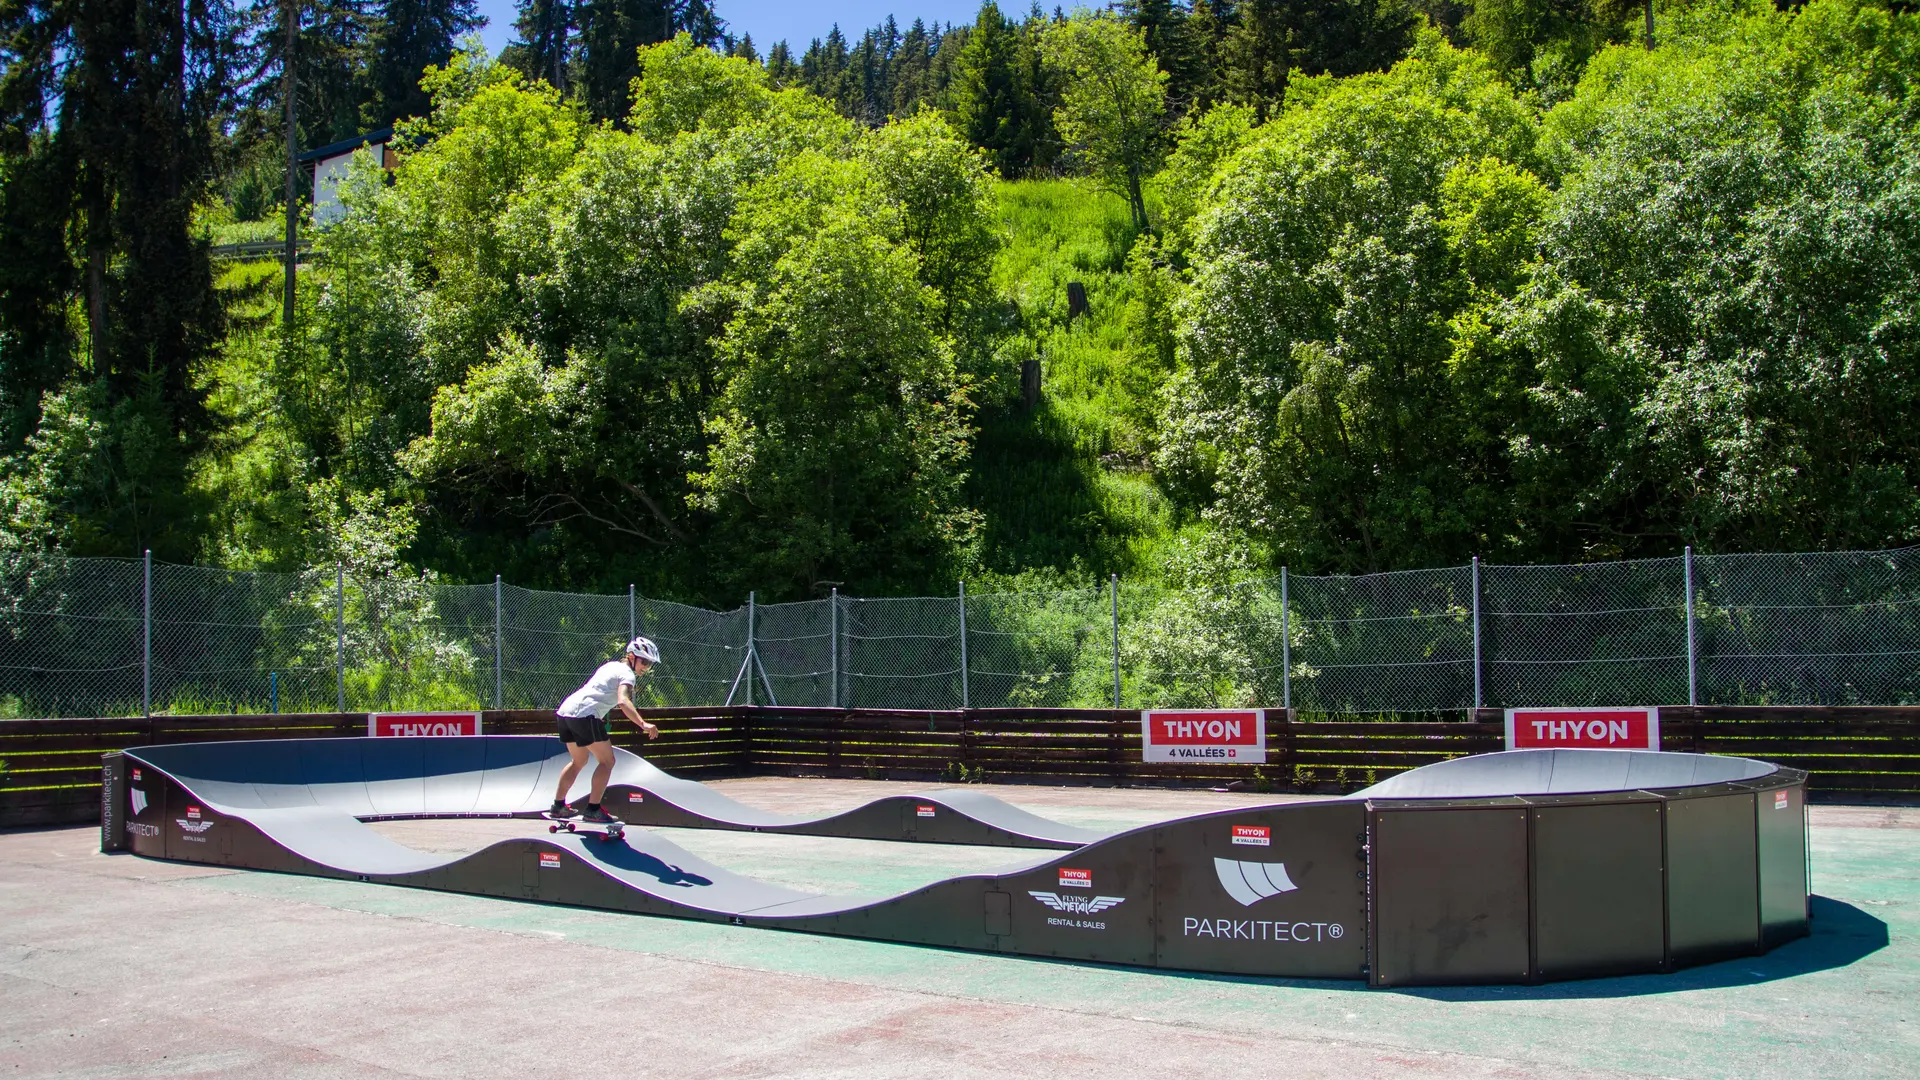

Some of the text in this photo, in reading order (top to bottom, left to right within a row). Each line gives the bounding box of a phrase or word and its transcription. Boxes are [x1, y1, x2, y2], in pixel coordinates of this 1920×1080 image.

[390, 723, 462, 736] THYON
[1163, 720, 1241, 741] THYON
[1531, 720, 1629, 744] THYON
[1169, 747, 1226, 758] 4 VALLÉES
[103, 765, 113, 842] www.parkitect.ch
[1237, 828, 1265, 837] THYON
[1063, 870, 1087, 879] THYON
[1062, 895, 1088, 903] FLYING
[1062, 902, 1089, 915] METAL
[1047, 917, 1074, 927] RENTAL
[1082, 921, 1106, 930] SALES
